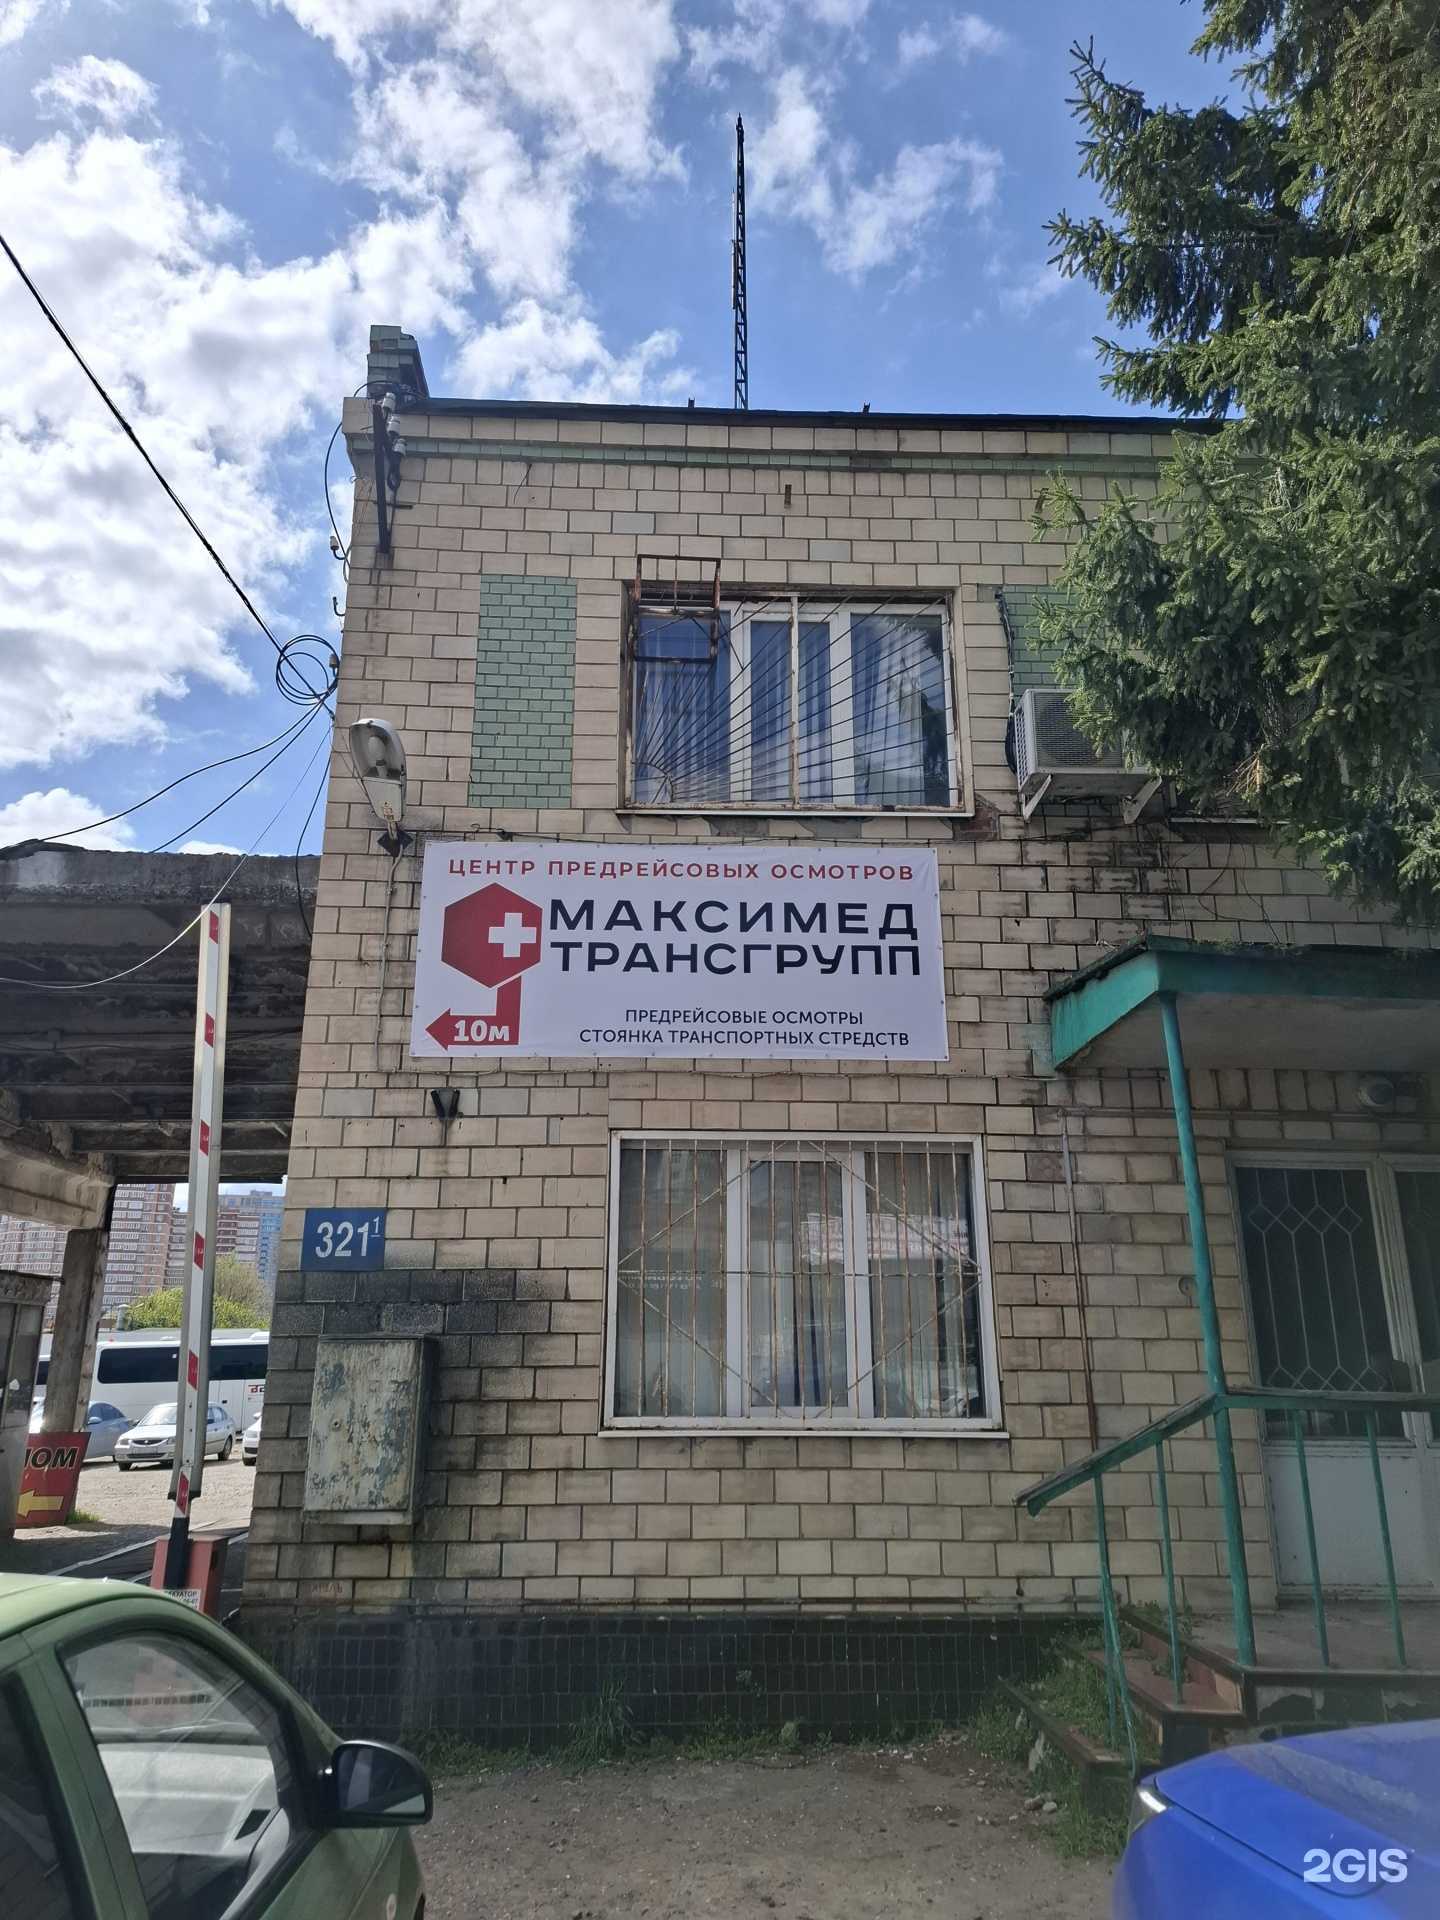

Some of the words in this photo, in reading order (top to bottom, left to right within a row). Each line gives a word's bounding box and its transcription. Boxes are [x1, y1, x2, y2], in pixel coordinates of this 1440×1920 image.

[449, 859, 536, 877] ЦЕНТР
[548, 858, 759, 879] ПРЕДРЕЙСОВЫХ
[771, 864, 913, 880] ОСМОТРОВ
[549, 898, 918, 941] МАКСИМЕД
[550, 941, 920, 976] ТРАНСГРУПП
[625, 1007, 767, 1025] ПРЕДРЕЙСОВЫЕ
[772, 1010, 863, 1025] ОСМОТРЫ
[453, 1019, 510, 1042] 10м
[579, 1028, 663, 1043] СТОЯНКА
[668, 1030, 814, 1045] ТРАНСПОРТНЫХ
[818, 1031, 909, 1048] СТРЕДСТВ
